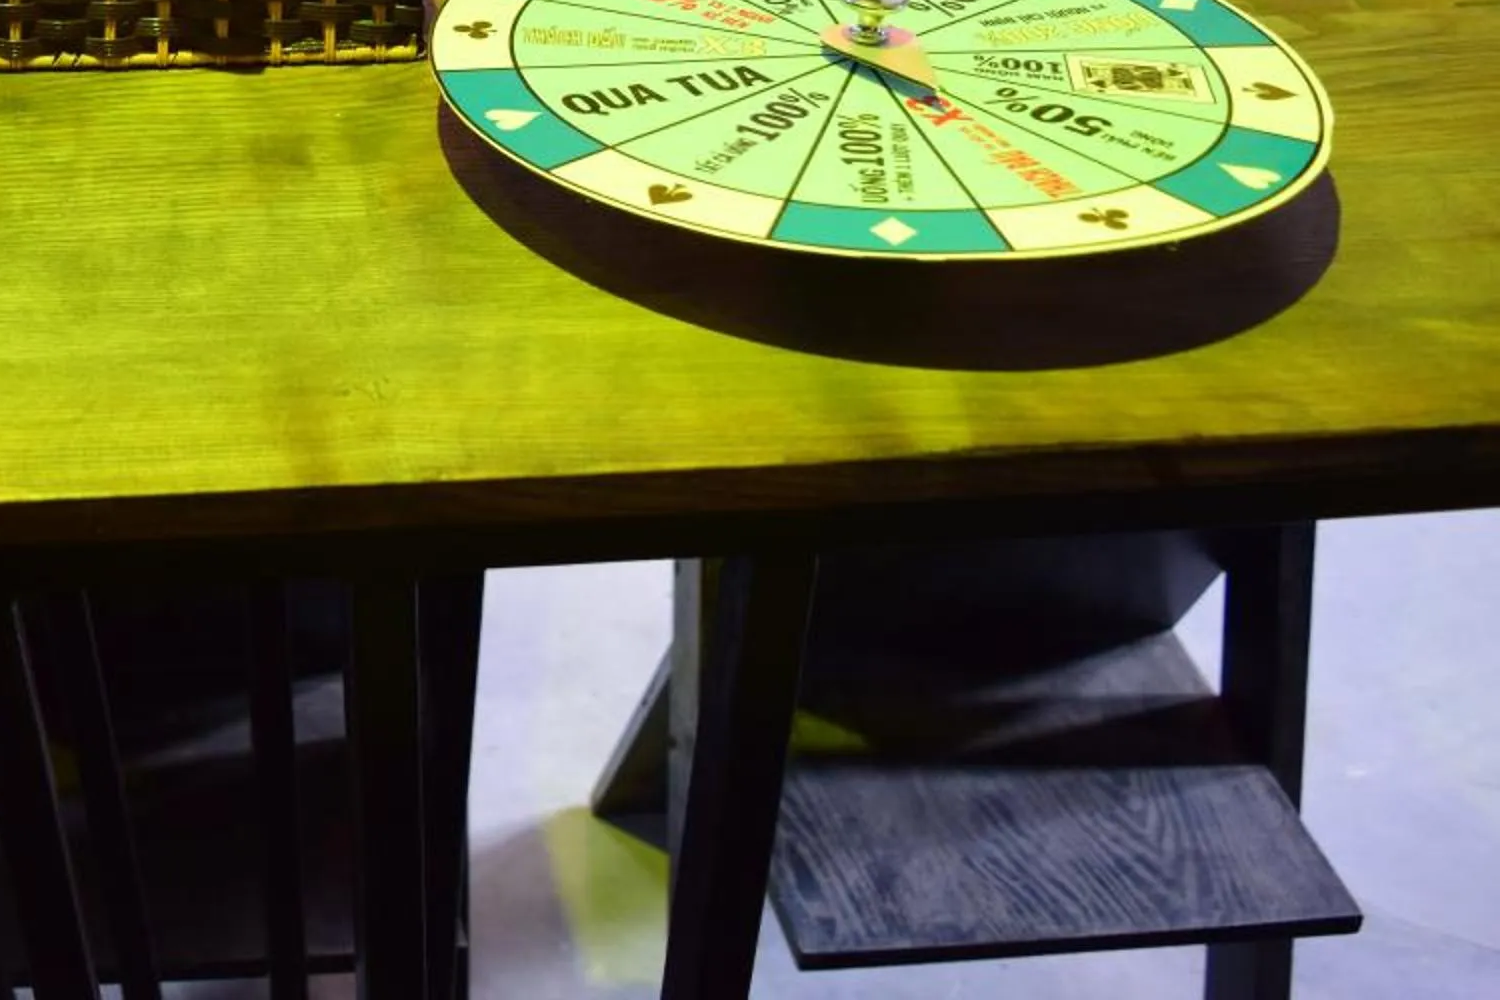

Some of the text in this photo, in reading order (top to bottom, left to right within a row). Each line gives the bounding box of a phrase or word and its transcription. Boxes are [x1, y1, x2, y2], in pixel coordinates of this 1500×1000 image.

[973, 55, 1061, 73] 100%
[560, 66, 772, 116] QUA TUA
[734, 88, 830, 141] 100%
[986, 87, 1111, 137] 50%
[838, 114, 888, 203] UỐNG 100%
